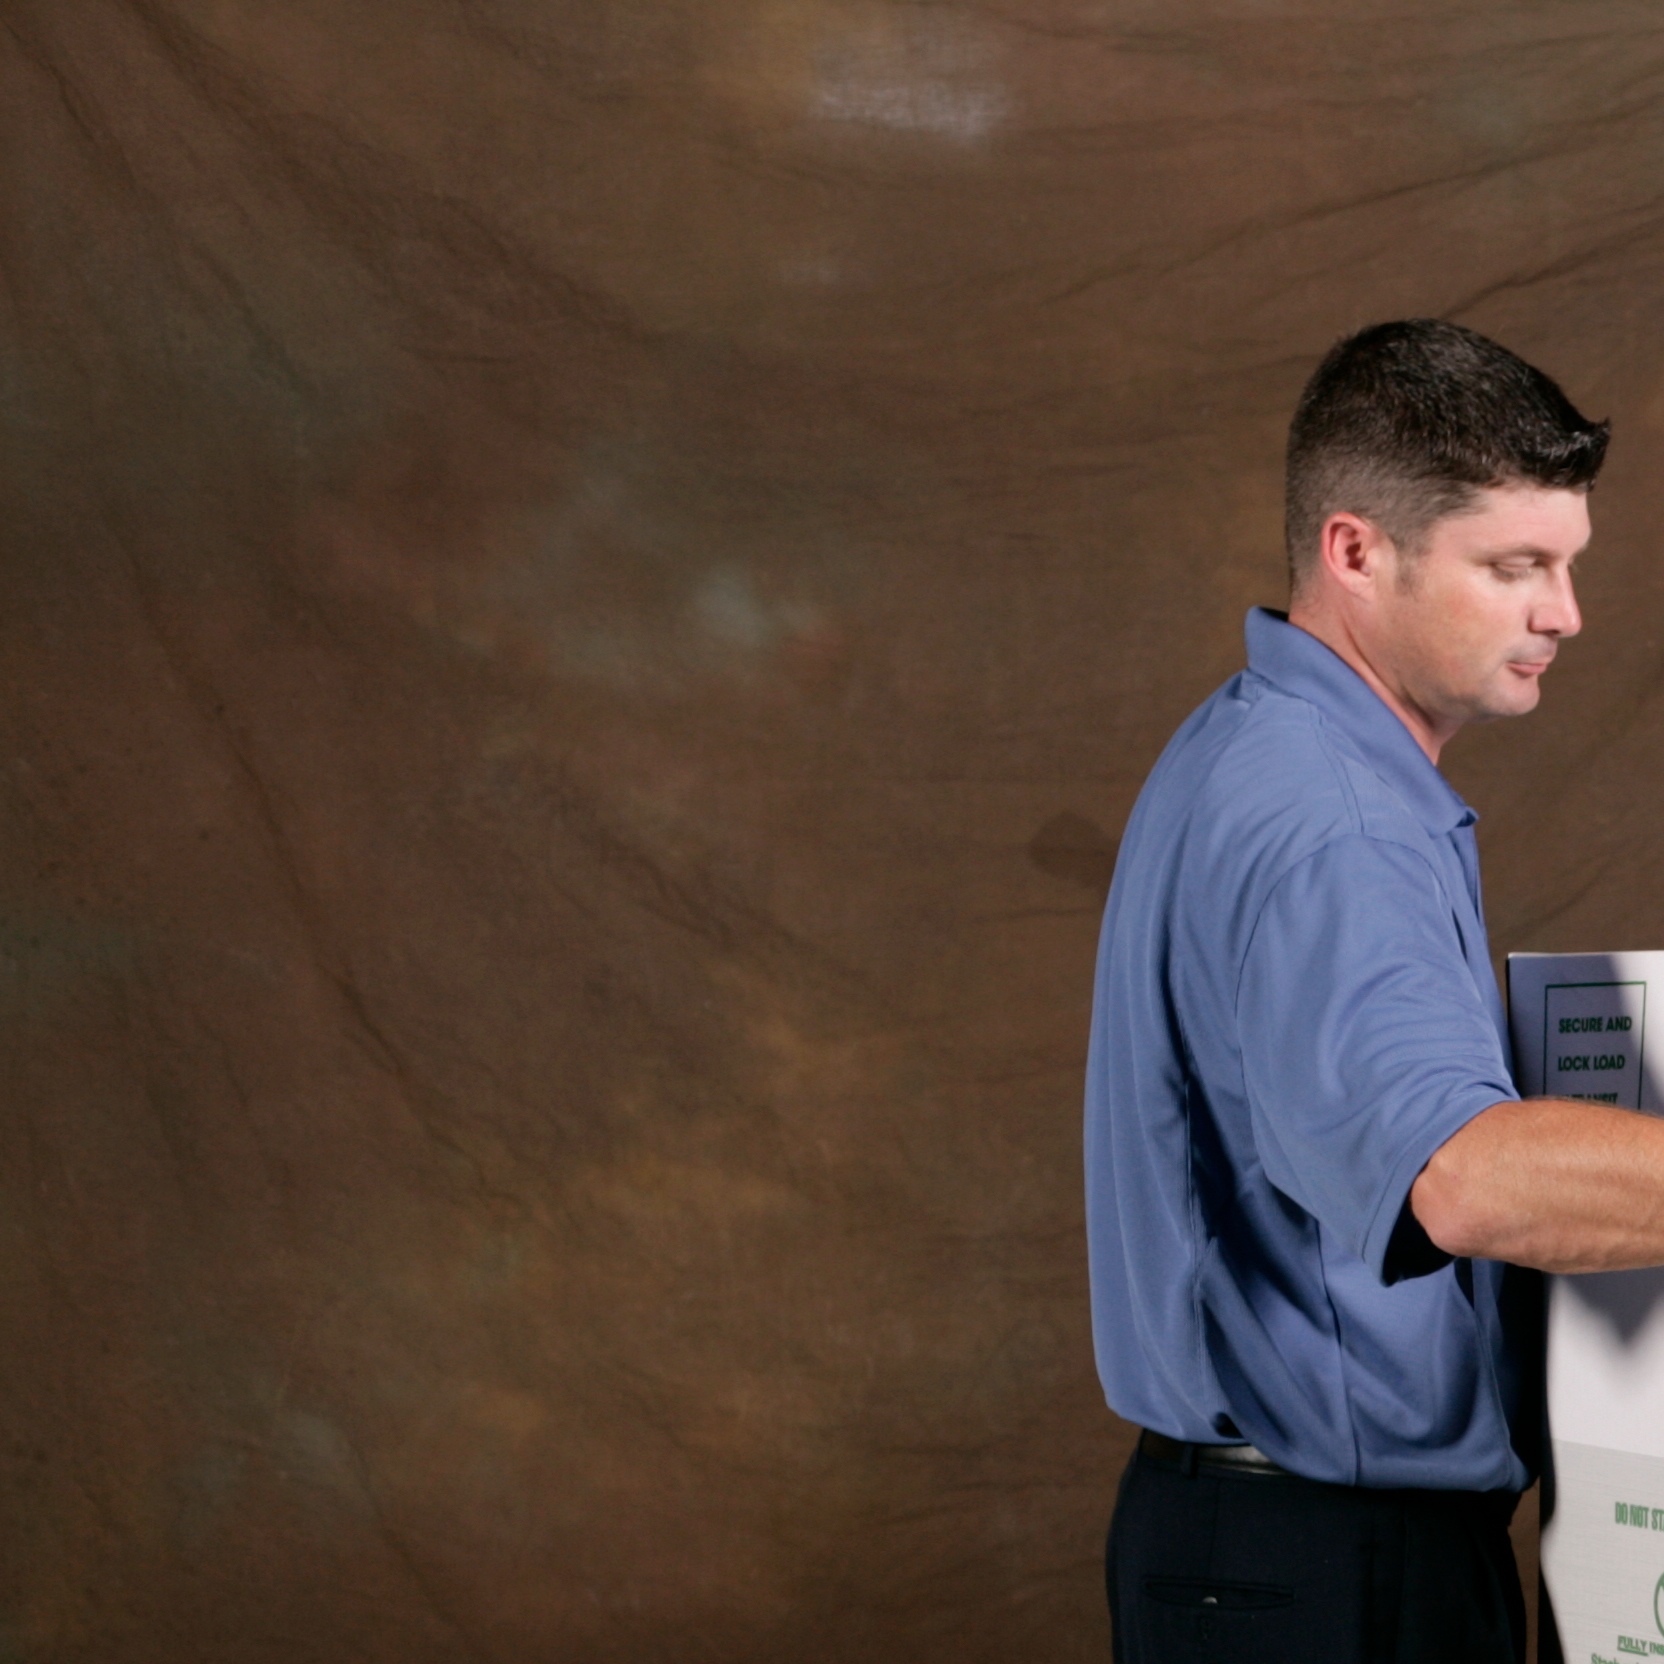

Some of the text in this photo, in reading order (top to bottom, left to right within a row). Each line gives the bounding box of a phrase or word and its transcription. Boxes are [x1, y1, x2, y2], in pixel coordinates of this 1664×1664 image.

[1558, 1016, 1633, 1033] SECURE AND
[1558, 1054, 1626, 1072] LOCK LOAD
[1615, 1501, 1628, 1525] DO
[1629, 1504, 1649, 1528] NOT
[1617, 1635, 1648, 1654] FULLY
